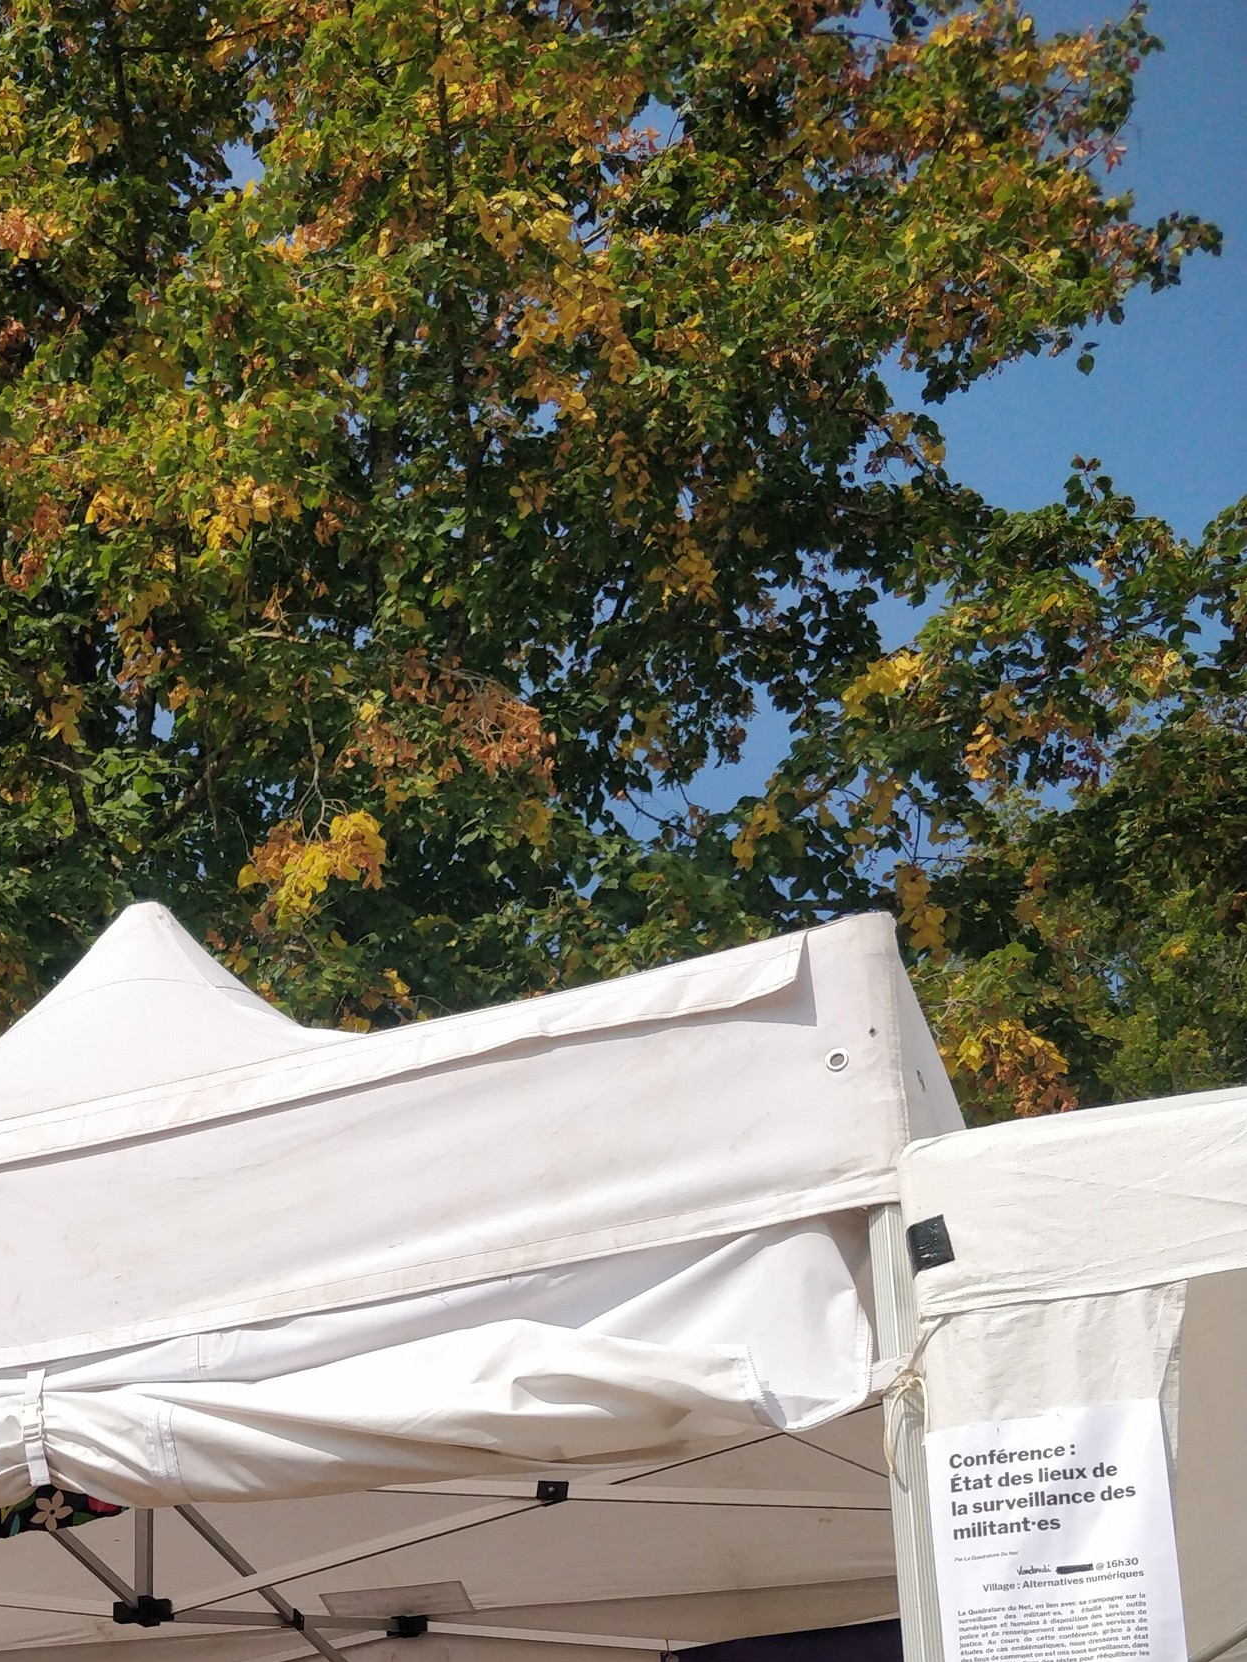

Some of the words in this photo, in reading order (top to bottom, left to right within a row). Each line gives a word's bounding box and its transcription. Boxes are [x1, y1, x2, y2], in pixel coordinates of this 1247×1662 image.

[949, 1445, 1066, 1469] Conférence
[950, 1473, 993, 1493] État
[997, 1472, 1034, 1487] des
[1038, 1466, 1087, 1483] lieux
[1092, 1462, 1118, 1478] de
[952, 1501, 968, 1516] la
[973, 1490, 1096, 1513] surveillance
[1100, 1485, 1136, 1501] des
[953, 1517, 1061, 1540] militant·es
[1106, 1557, 1139, 1569] 16h30
[983, 1583, 1016, 1593] Village
[1023, 1577, 1084, 1588] Alternatives
[1086, 1570, 1144, 1583] numériques
[968, 1607, 1005, 1616] Quadrature
[959, 1616, 997, 1624] surveillance
[959, 1623, 997, 1632] numériques
[1050, 1616, 1088, 1624] disposition
[1002, 1627, 1054, 1635] renseignement
[1088, 1636, 1119, 1644] dressons
